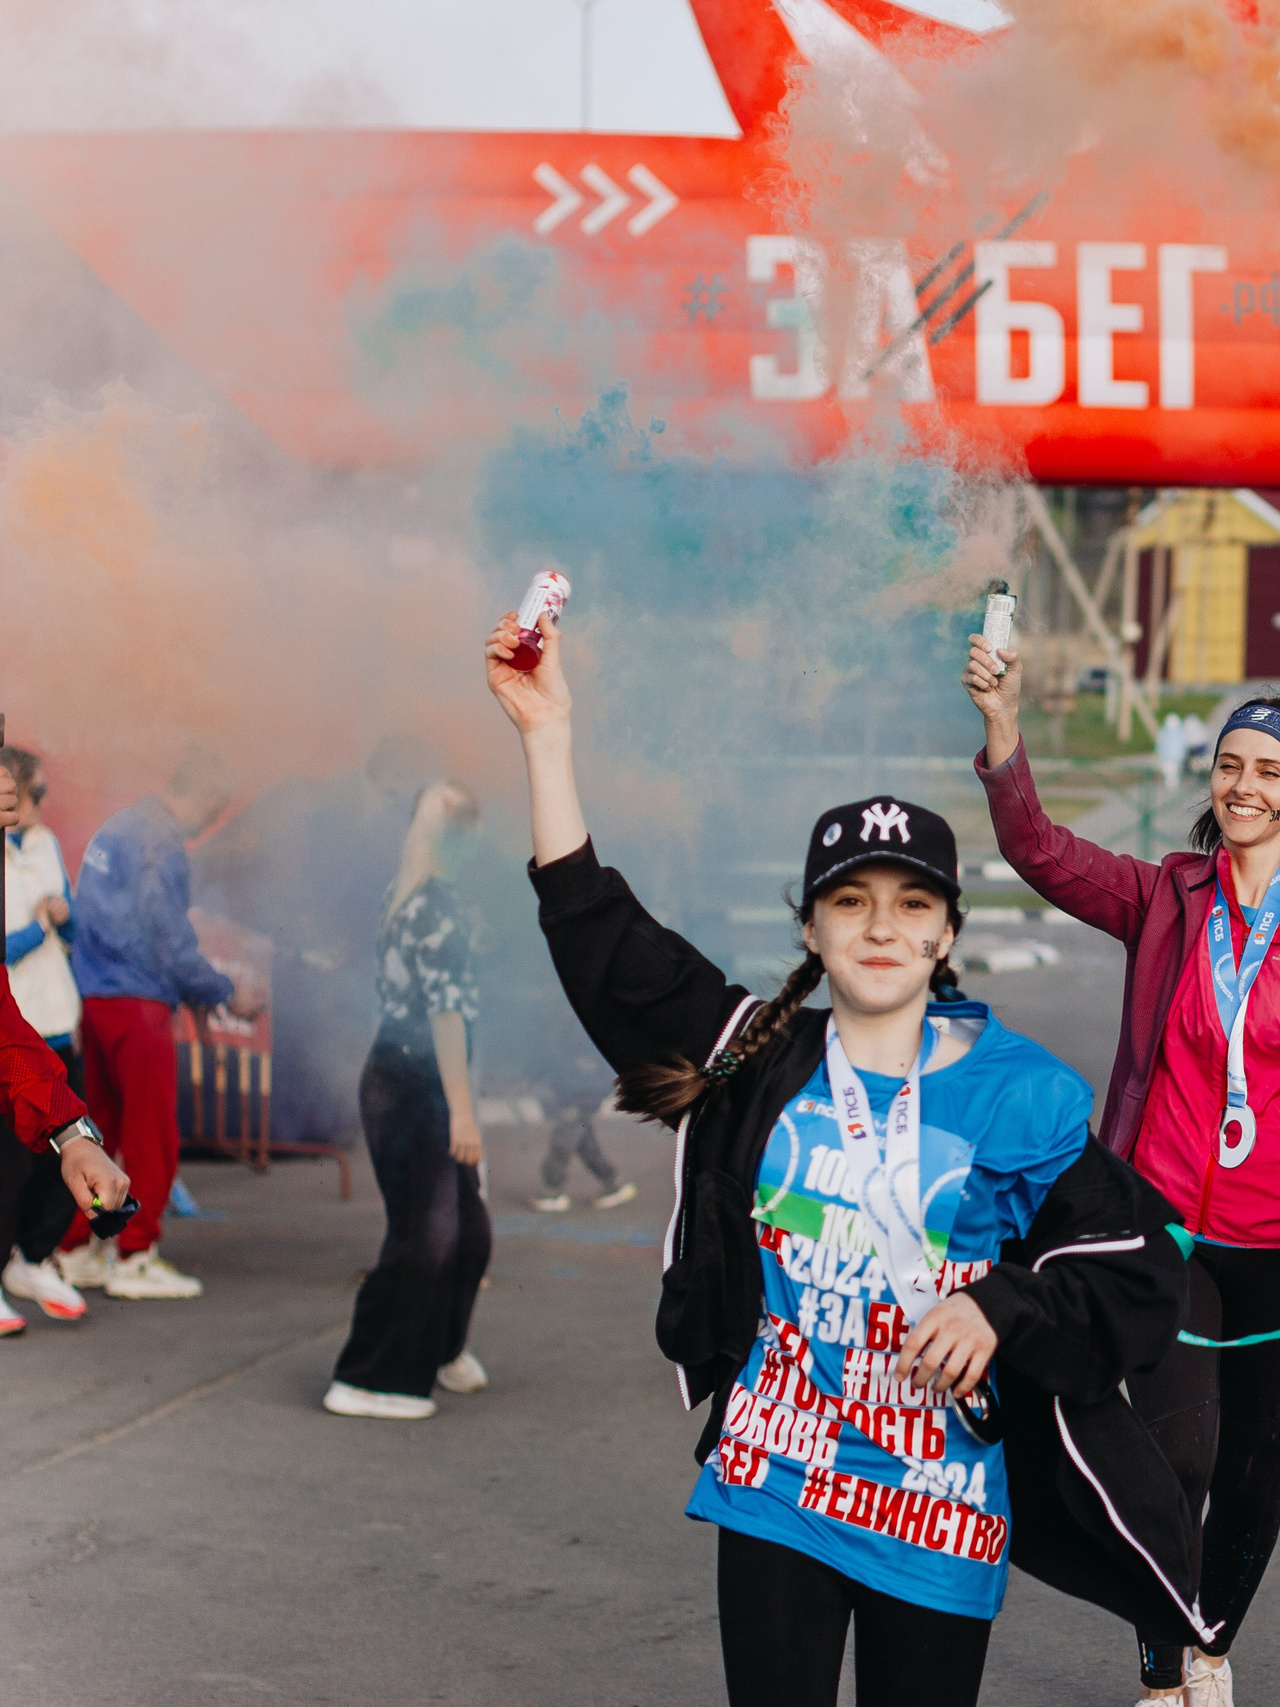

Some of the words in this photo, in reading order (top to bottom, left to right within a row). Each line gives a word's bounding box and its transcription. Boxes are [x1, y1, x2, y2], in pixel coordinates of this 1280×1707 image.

[1213, 918, 1224, 942] ПСБ
[1258, 911, 1275, 931] ПСБ
[814, 1103, 837, 1119] ПС
[843, 1087, 860, 1119] ПСБ
[896, 1101, 908, 1135] ПСБ
[788, 1232, 888, 1301] 2024
[797, 1285, 910, 1353] #ЗАБЕ
[799, 1466, 1008, 1564] #ЕДИНСТВО
